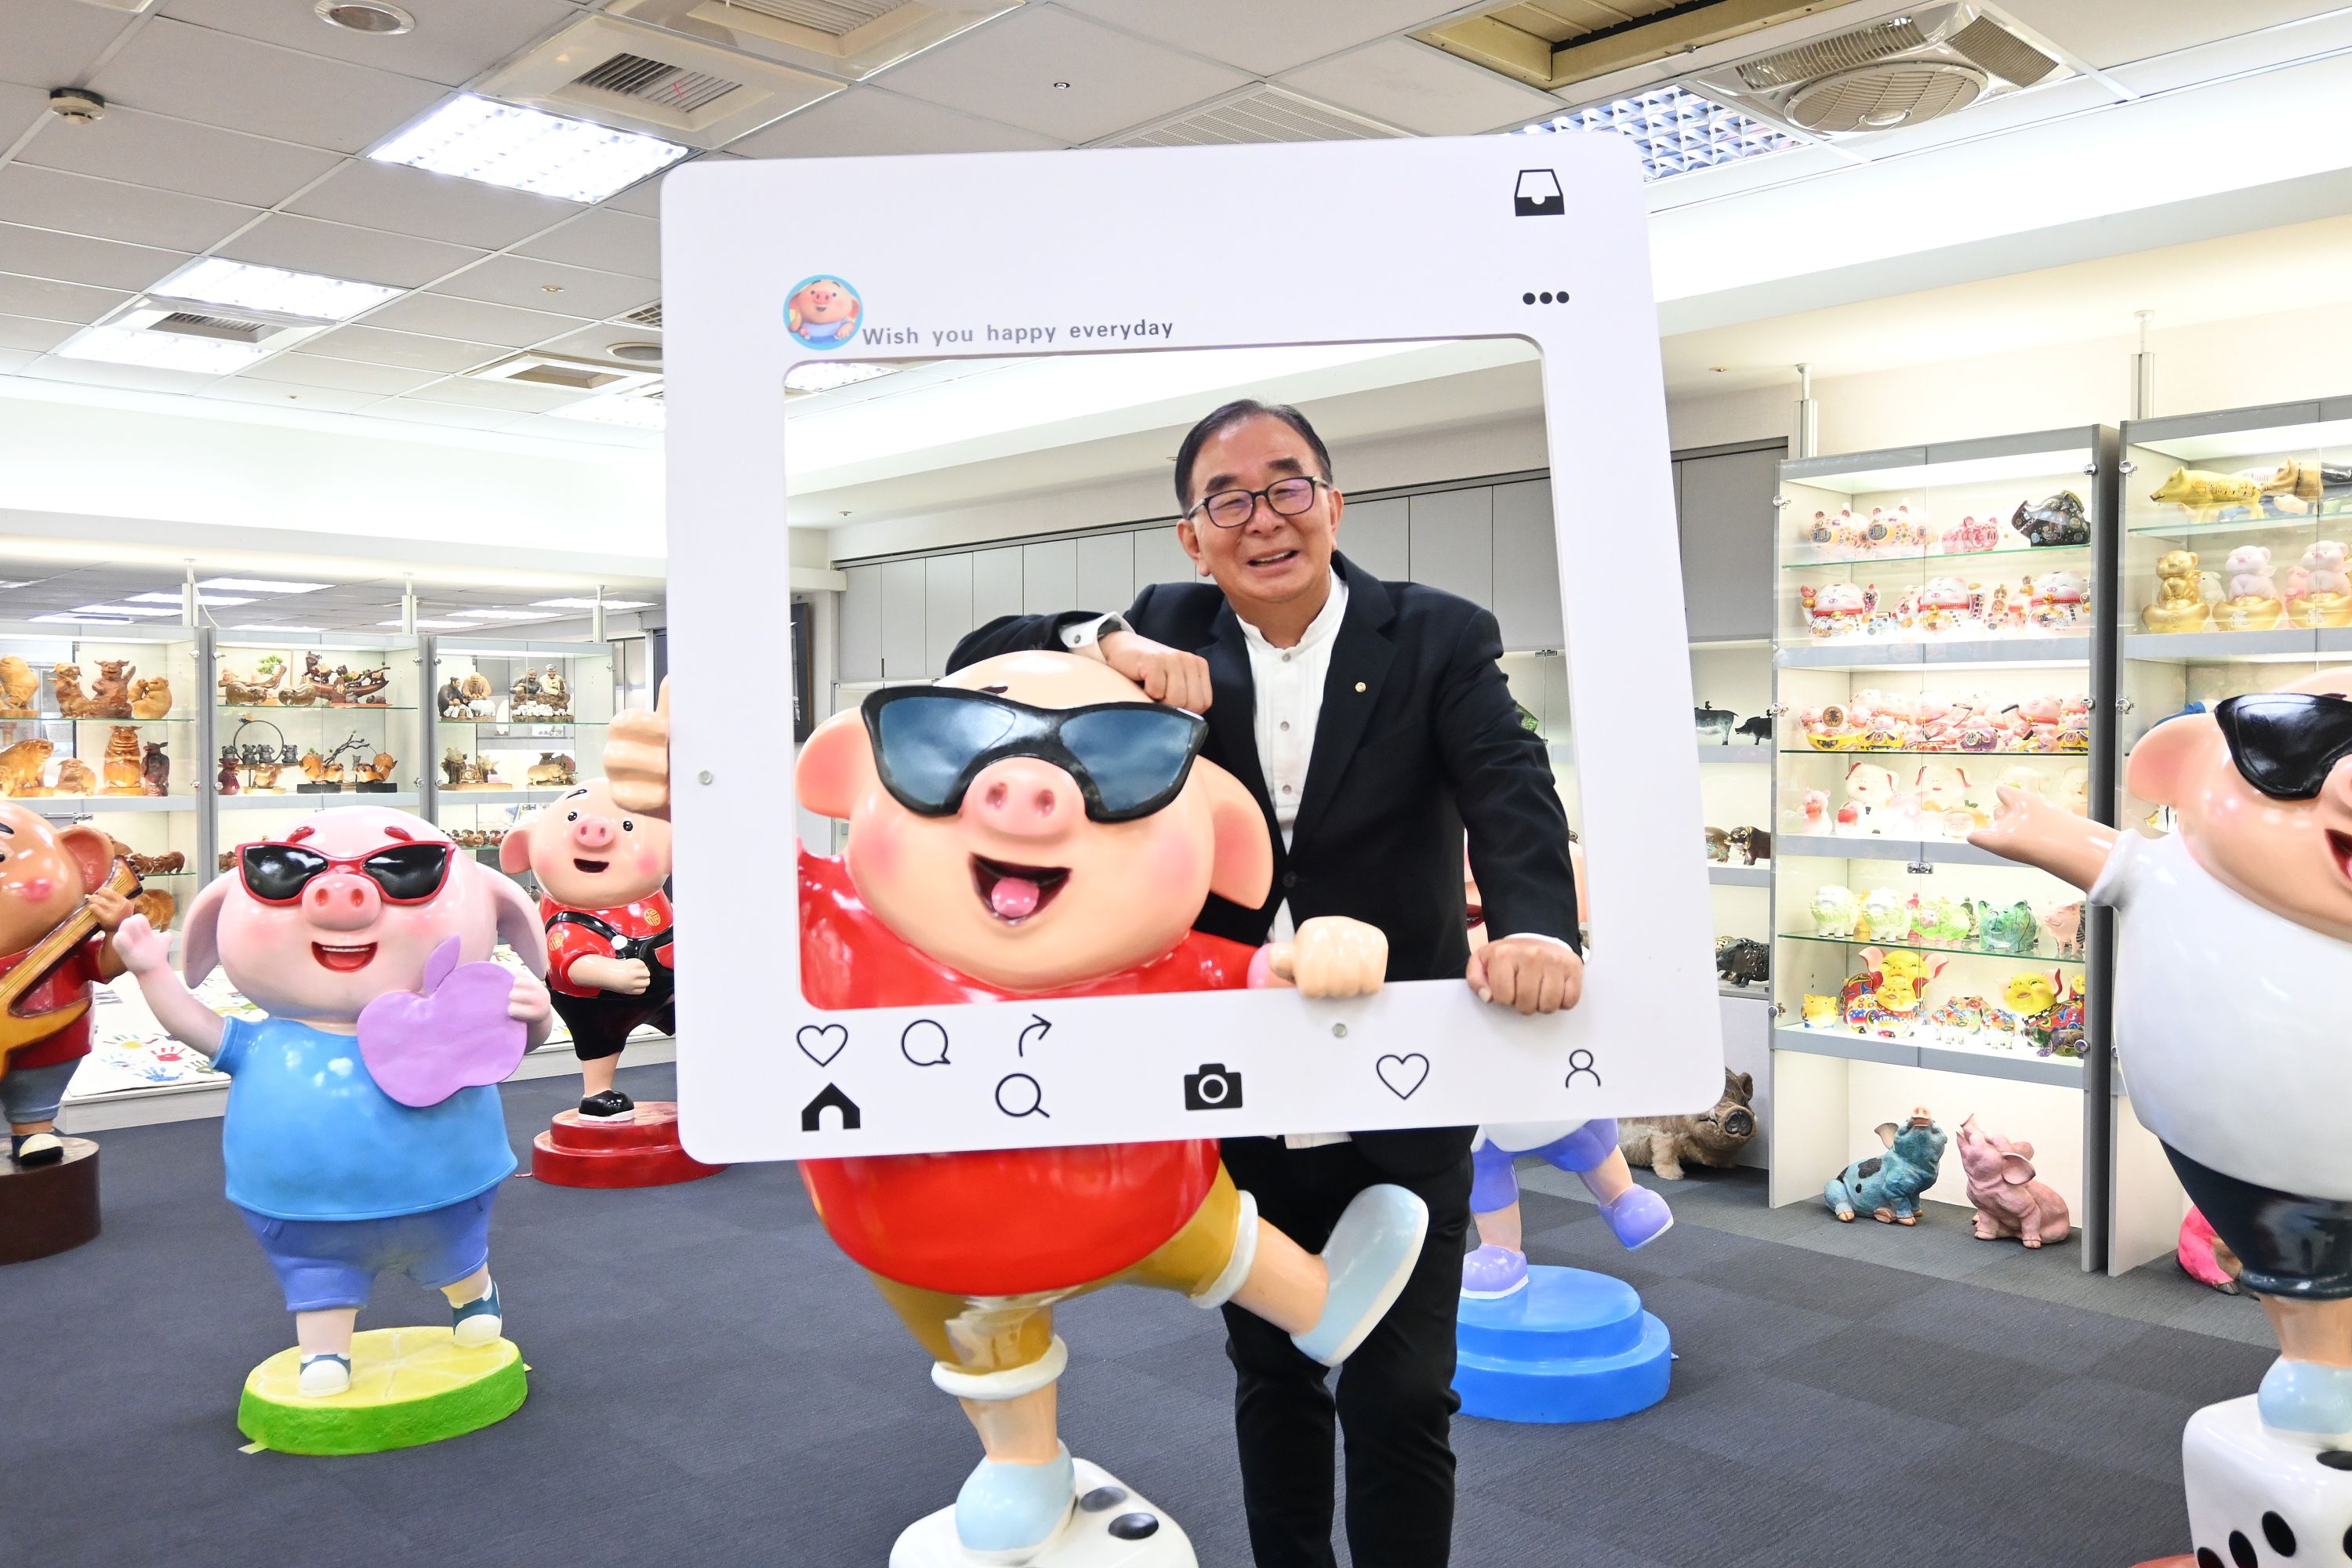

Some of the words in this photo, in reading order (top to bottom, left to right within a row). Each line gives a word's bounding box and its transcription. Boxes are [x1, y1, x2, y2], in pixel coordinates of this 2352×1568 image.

[862, 327, 919, 345] Wish
[932, 329, 974, 347] you
[986, 324, 1056, 343] happy
[1069, 318, 1174, 340] everyday
